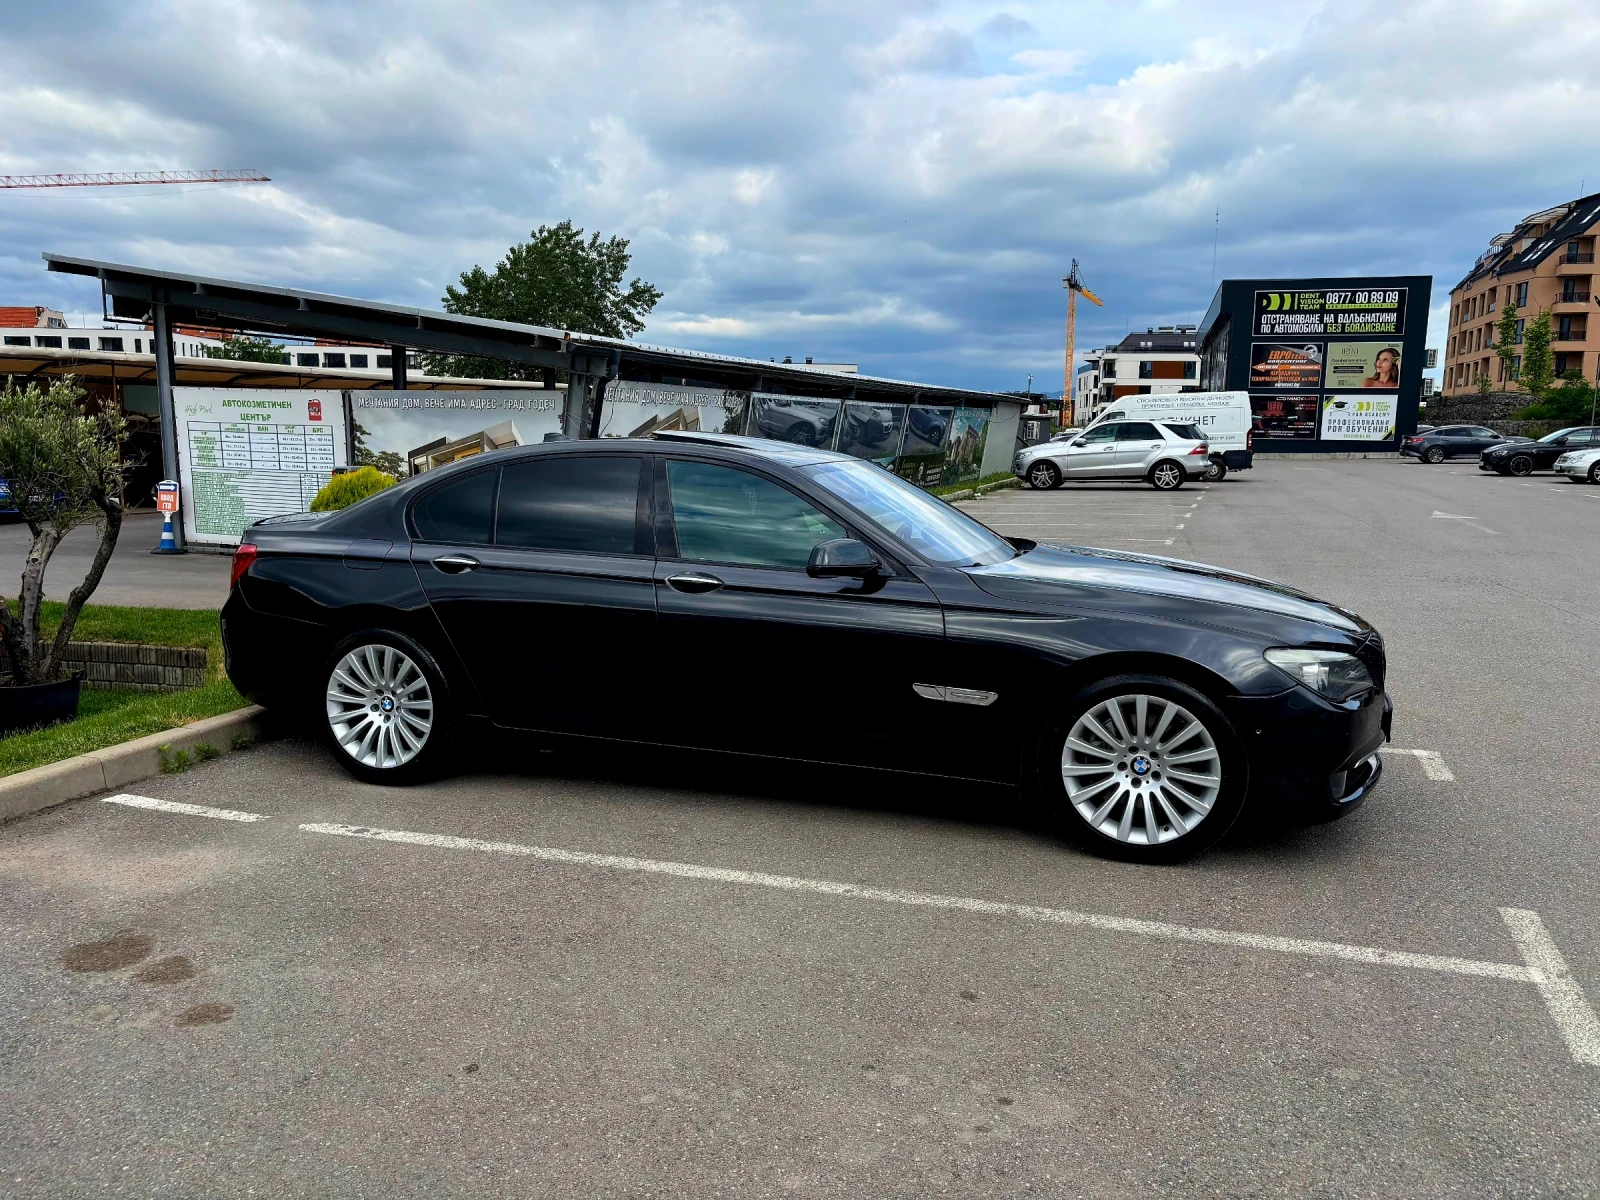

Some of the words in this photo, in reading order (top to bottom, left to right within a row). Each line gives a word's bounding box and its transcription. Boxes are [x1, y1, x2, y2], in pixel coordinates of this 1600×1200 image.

[1326, 292, 1352, 304] 0877
[1355, 291, 1369, 304] 00
[1370, 291, 1384, 304] 89
[1386, 291, 1399, 303] 09
[1261, 314, 1320, 324] ОТСТРАНЯВАНЕ
[1323, 314, 1335, 323] НА
[1338, 312, 1397, 323] ВДЛЪБНАТИНИ
[1261, 324, 1271, 333] ПО
[1274, 323, 1324, 333] АВТОМОБИЛИ
[1327, 323, 1342, 333] БЕЗ
[1345, 322, 1396, 333] БОЯДИСВАНЕ
[222, 399, 292, 409] АВТОКОЗМЕТИЧЕН
[358, 398, 400, 409] МЕЧТАНИЯ
[402, 398, 424, 411] ДОМ,
[424, 398, 445, 409] ВЕЧЕ
[448, 398, 468, 409] ИМА
[470, 398, 497, 411] АДРЕС
[503, 399, 525, 411] ГРАД
[528, 399, 555, 412] ГОДЕЧ
[240, 413, 272, 422] ЦЕНТЪР
[1346, 425, 1389, 433] ОБУЧЕНИЯ
